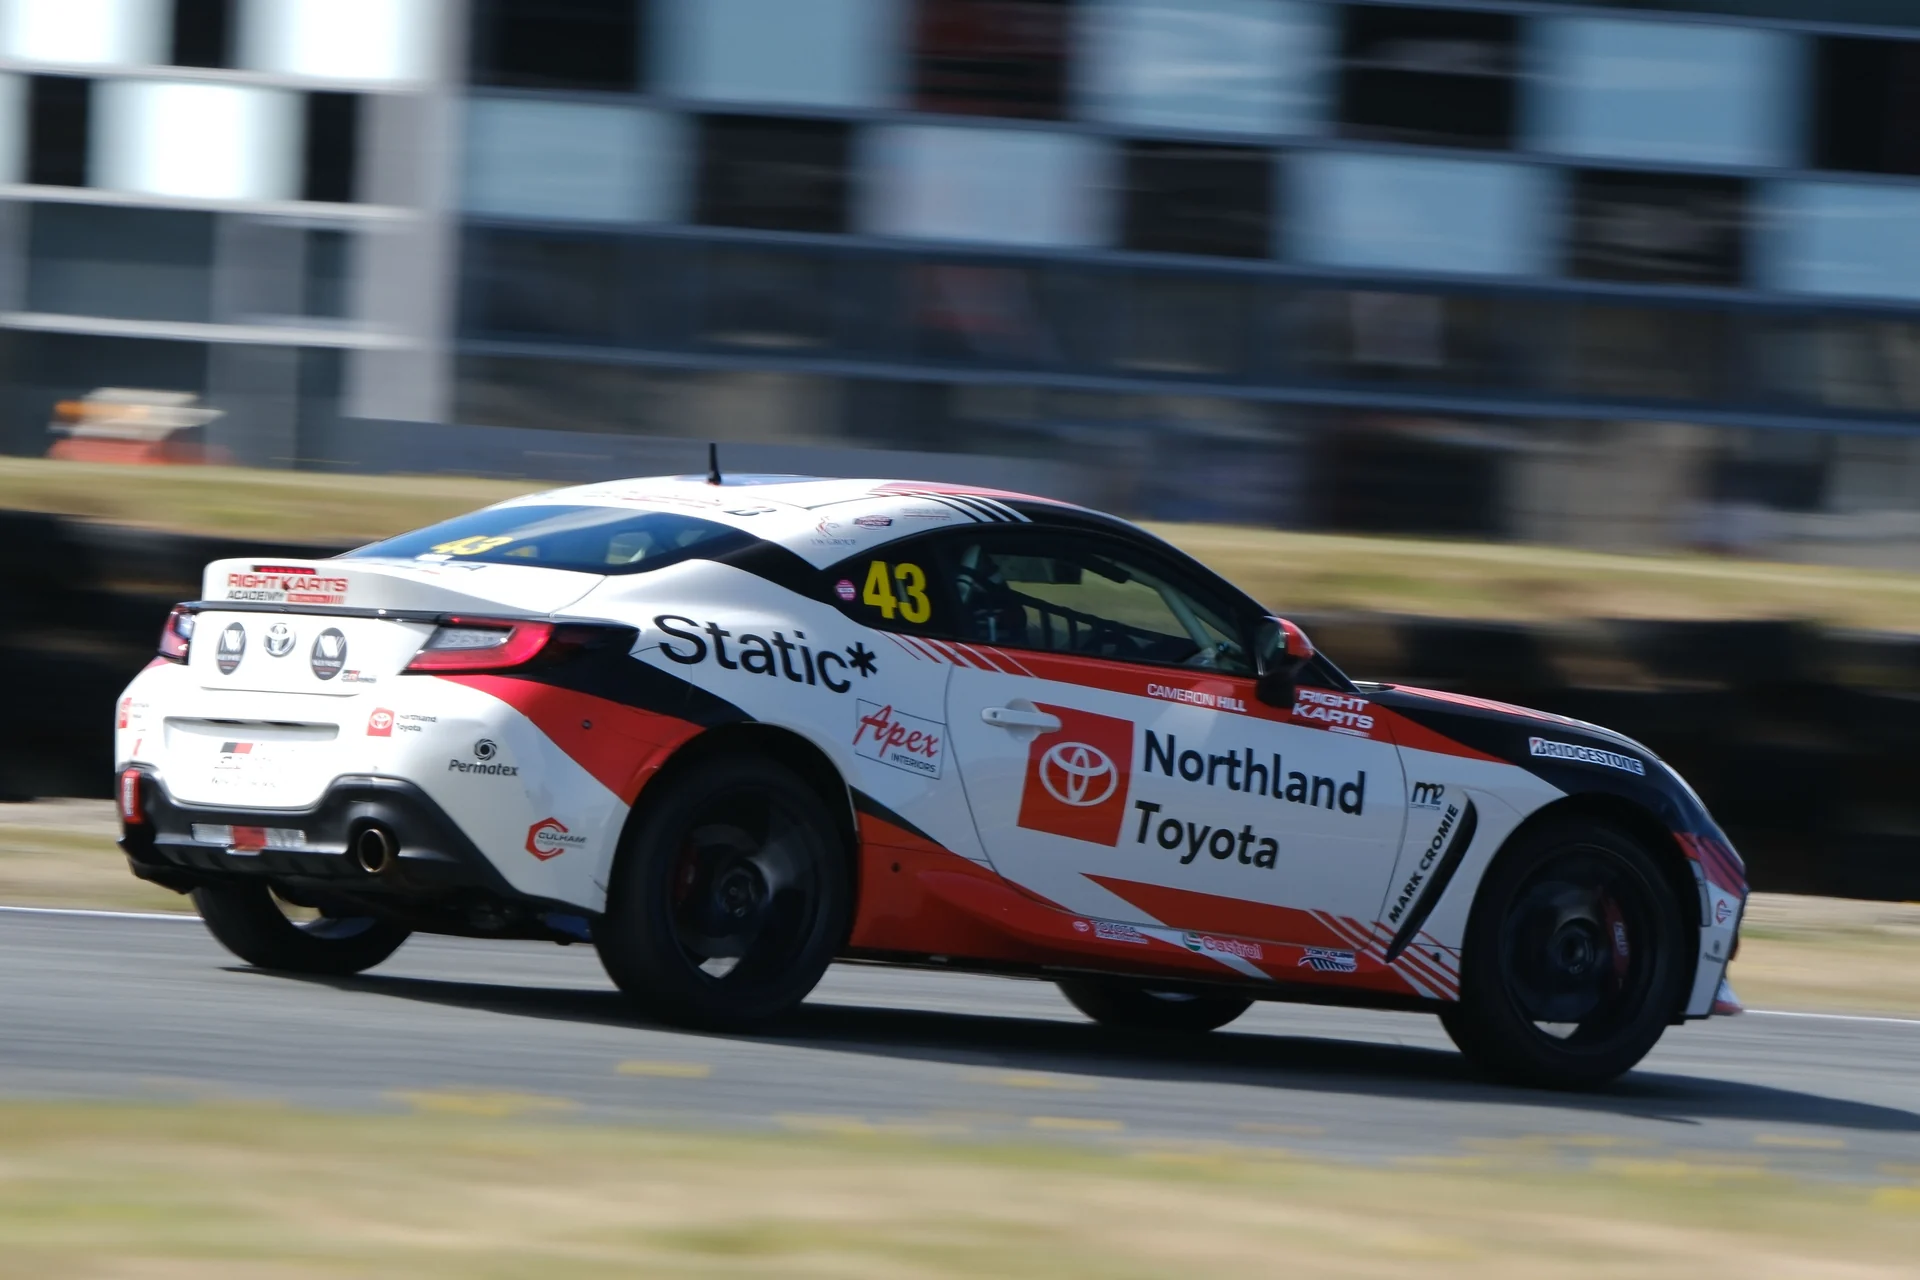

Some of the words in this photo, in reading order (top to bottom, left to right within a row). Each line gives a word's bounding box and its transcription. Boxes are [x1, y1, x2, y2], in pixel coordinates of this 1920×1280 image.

[862, 560, 931, 624] 43
[1147, 683, 1214, 708] CAMERON
[1217, 695, 1247, 713] HILL
[1299, 690, 1369, 713] RIGHT
[1292, 703, 1375, 730] KARTS
[852, 704, 940, 758] Apex
[448, 759, 519, 777] Permatex
[890, 752, 936, 773] INTERIORS
[1530, 738, 1643, 775] BRIDGESTONE
[1143, 729, 1366, 816] Northland
[538, 832, 588, 844] CULHAM
[1134, 800, 1280, 870] Toyota
[1388, 870, 1424, 925] MARK
[1419, 803, 1459, 872] CROMIE
[1202, 935, 1264, 960] Castrol
[1304, 947, 1328, 957] TONY
